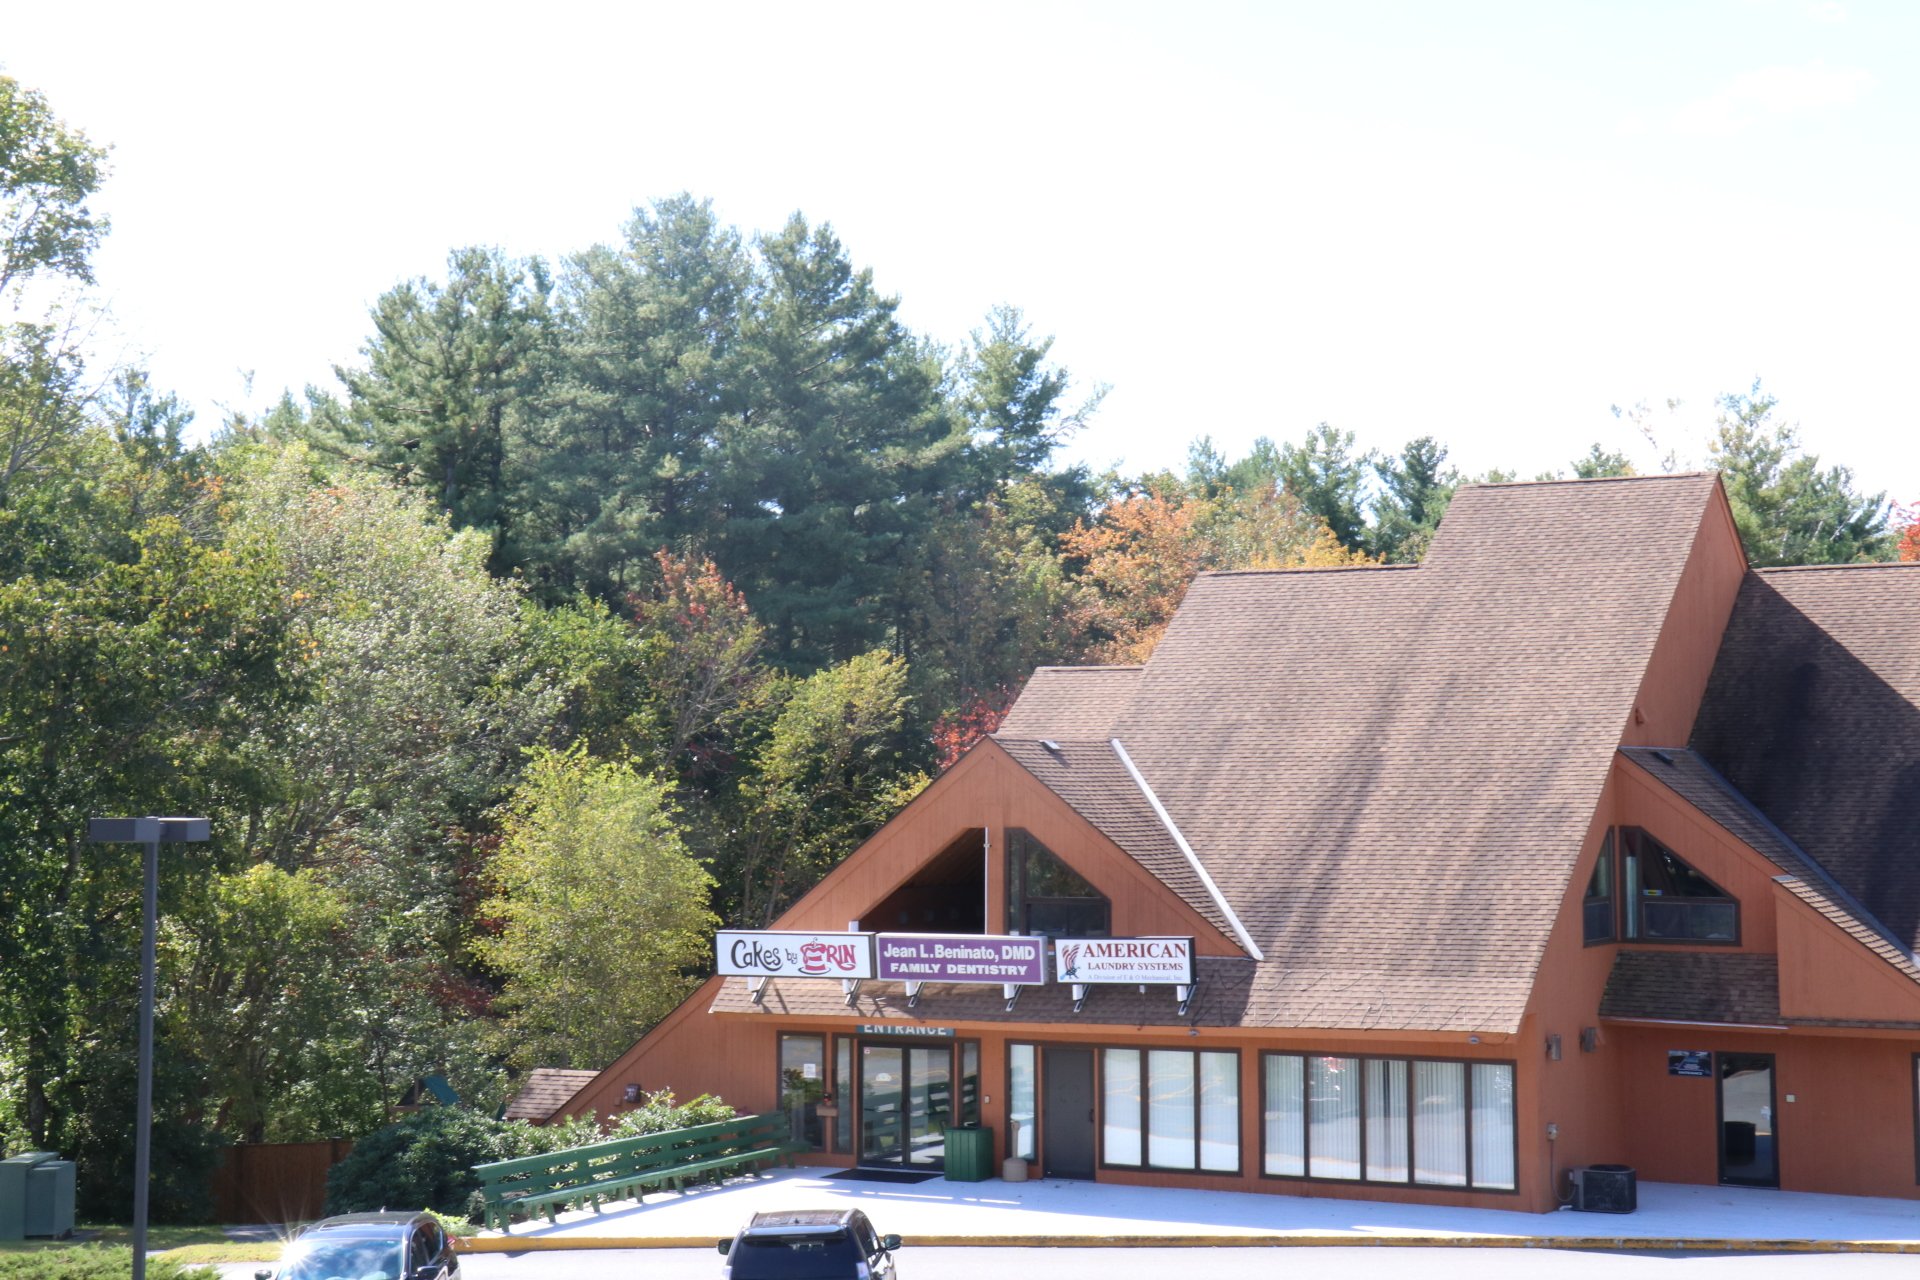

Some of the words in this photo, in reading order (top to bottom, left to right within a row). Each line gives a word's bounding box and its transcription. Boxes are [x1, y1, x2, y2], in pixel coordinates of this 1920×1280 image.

[730, 939, 783, 972] Cakes
[785, 948, 798, 965] by
[799, 939, 857, 973] ERIN
[883, 943, 917, 958] Jean
[934, 944, 999, 962] Beninato,
[1002, 945, 1036, 960] DMD
[1082, 943, 1187, 958] AMERICAN
[890, 963, 941, 974] FAMILY
[947, 964, 1028, 976] DENTISTRY
[1088, 962, 1135, 971] LAUNDRY
[1137, 963, 1183, 971] SYSTEMS
[863, 1024, 947, 1036] ENTRANCE
